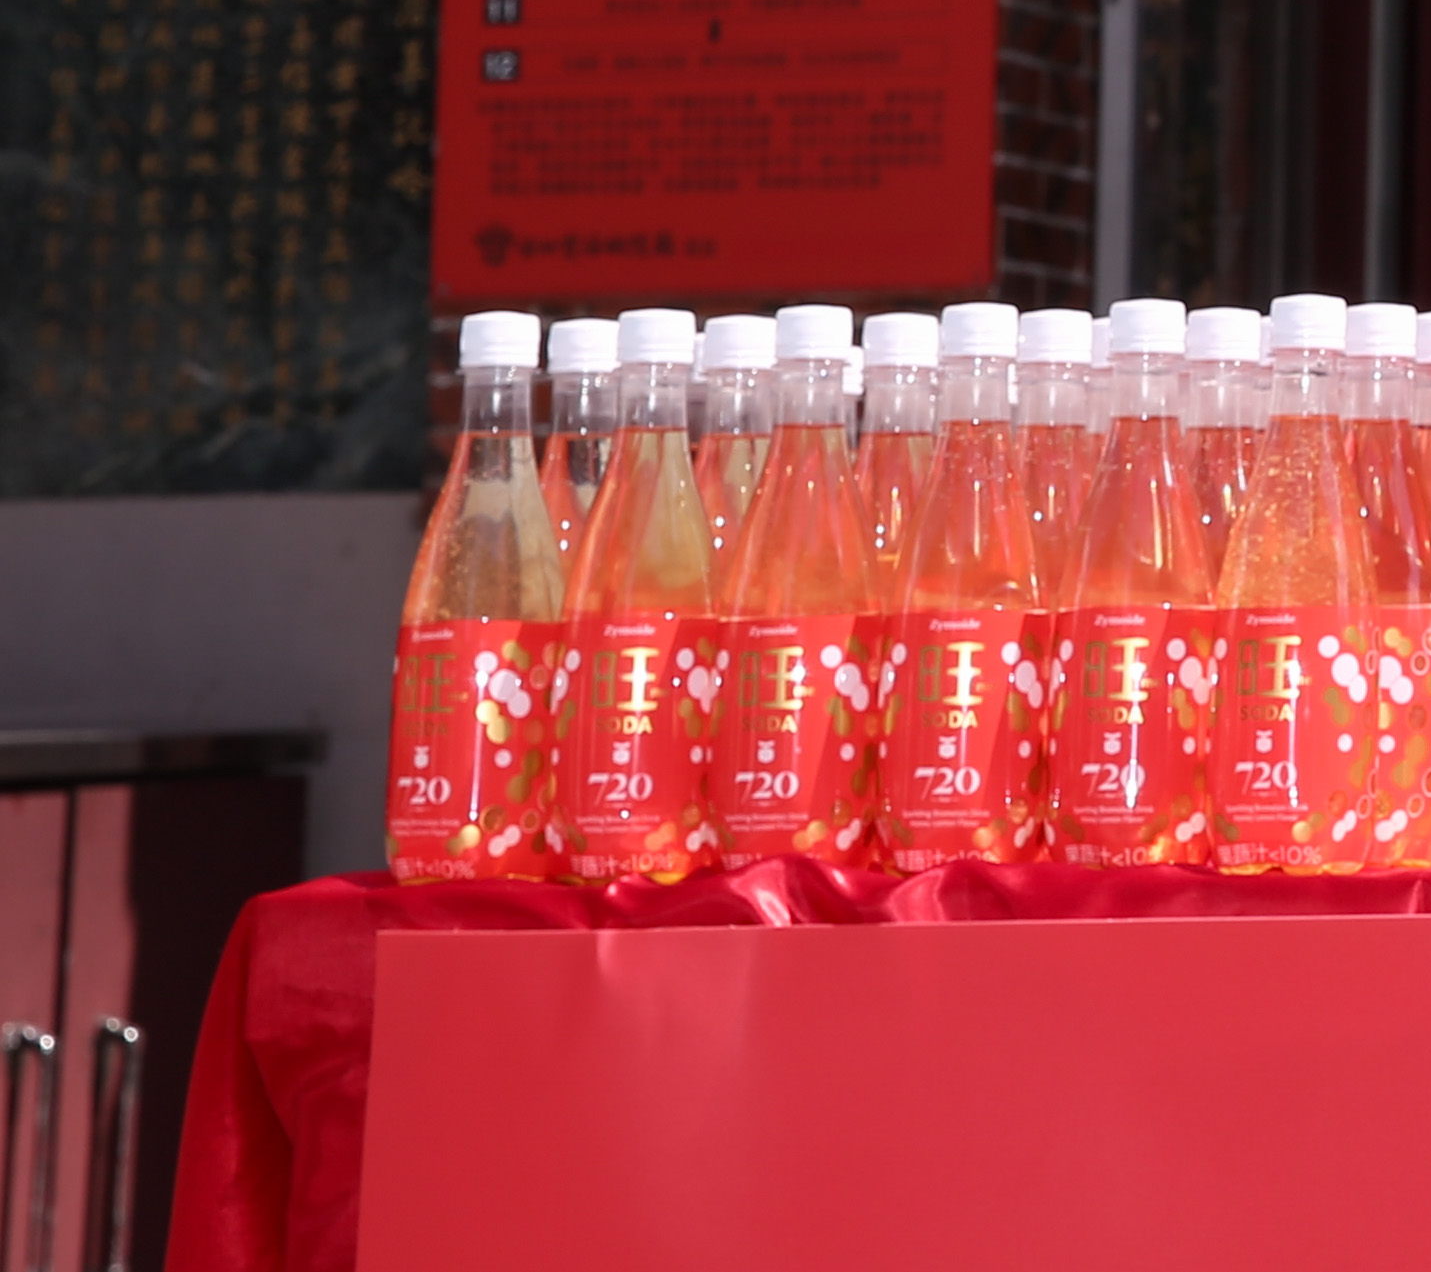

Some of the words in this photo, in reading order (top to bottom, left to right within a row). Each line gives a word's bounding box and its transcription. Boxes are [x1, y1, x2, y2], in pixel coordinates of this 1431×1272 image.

[397, 775, 451, 805] 720
[587, 772, 653, 805] 720
[734, 770, 800, 804] 720
[914, 766, 982, 800] 720
[1081, 763, 1146, 797] 720
[1234, 761, 1298, 795] 720
